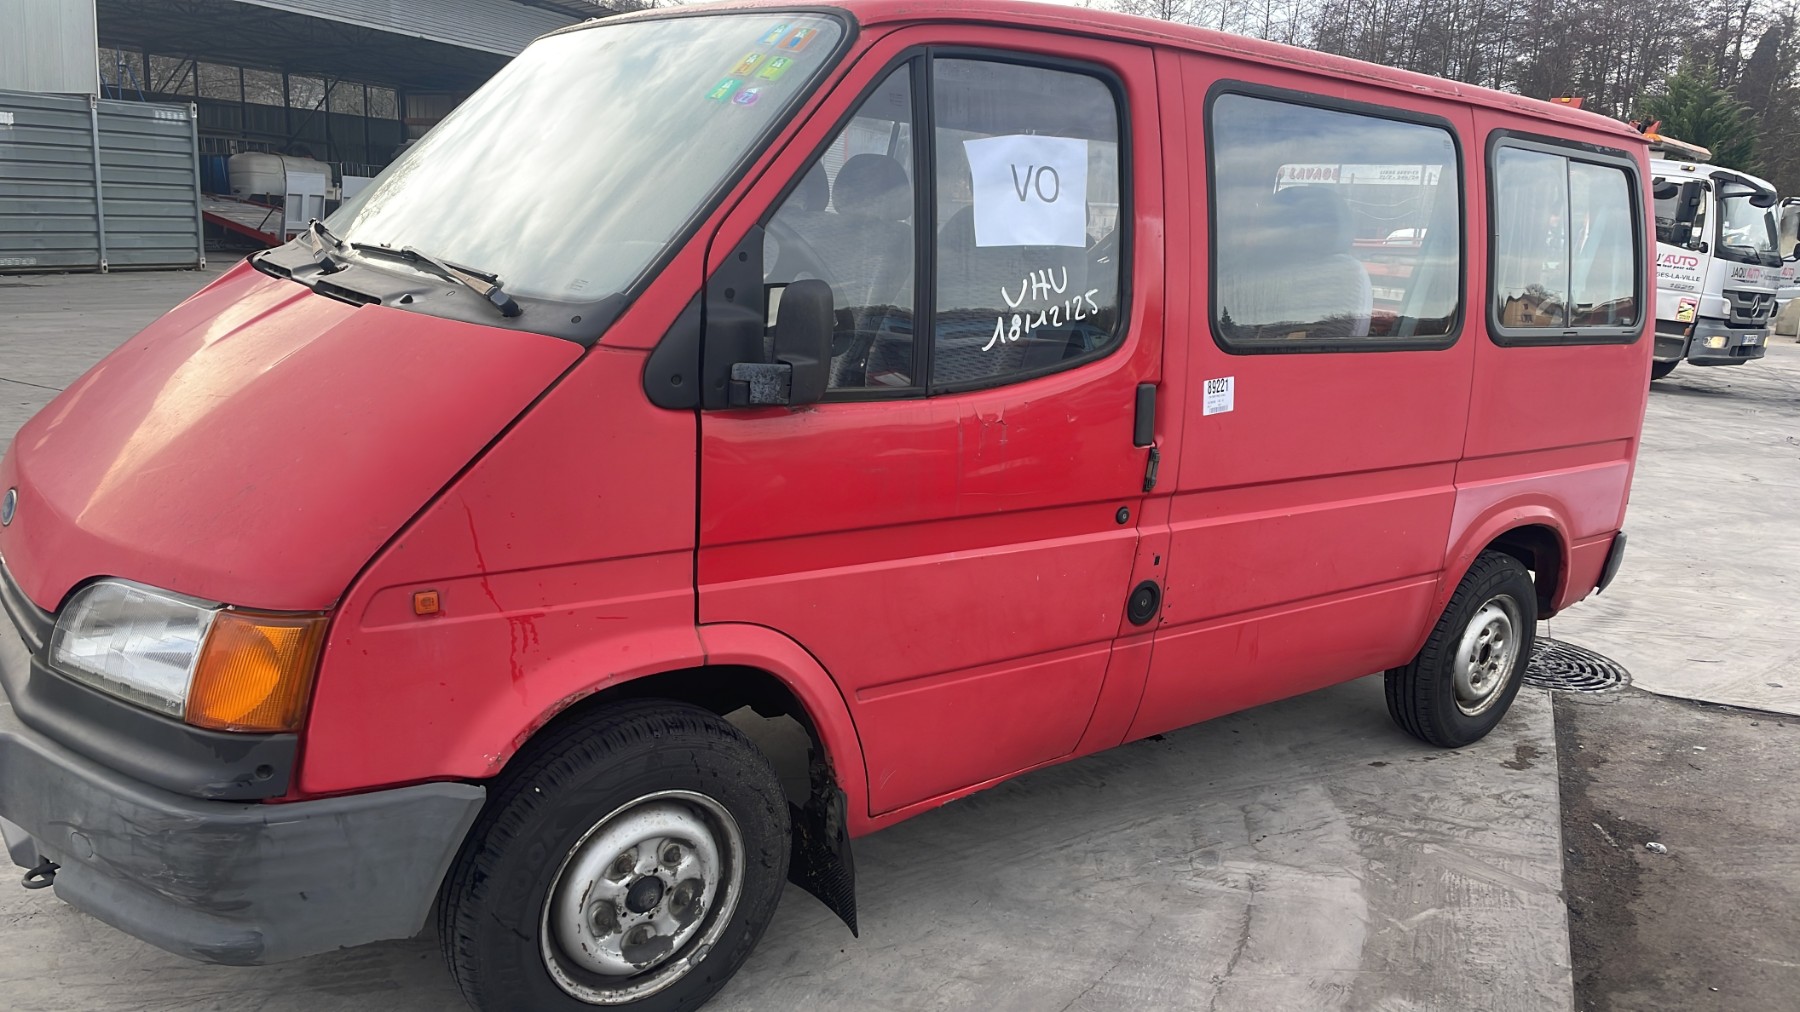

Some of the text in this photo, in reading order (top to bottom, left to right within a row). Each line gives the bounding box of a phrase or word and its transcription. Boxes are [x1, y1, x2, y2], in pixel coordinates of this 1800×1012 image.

[1010, 164, 1060, 203] VO
[1001, 266, 1068, 308] VHU
[1207, 378, 1229, 395] 89221
